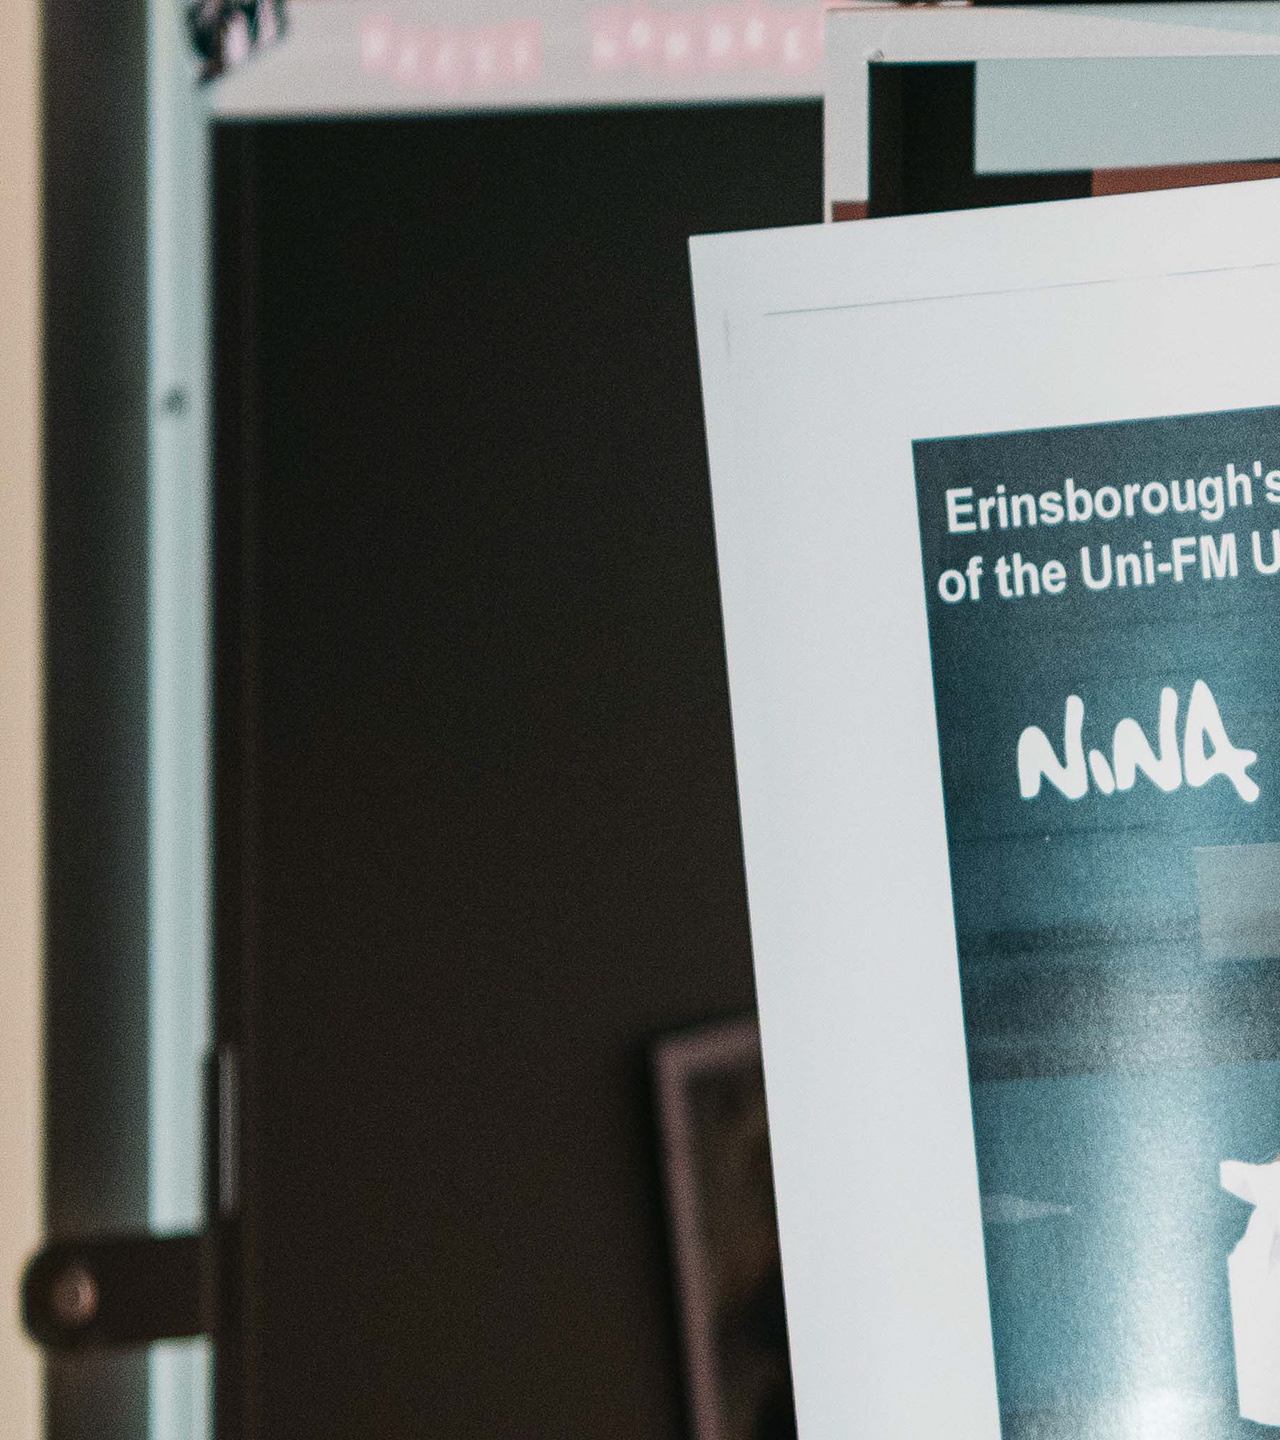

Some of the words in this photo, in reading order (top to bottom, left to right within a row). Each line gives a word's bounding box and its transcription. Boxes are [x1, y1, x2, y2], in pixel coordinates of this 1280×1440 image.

[937, 556, 983, 603] of
[994, 547, 1067, 598] the
[1080, 533, 1239, 591] Uni-FM
